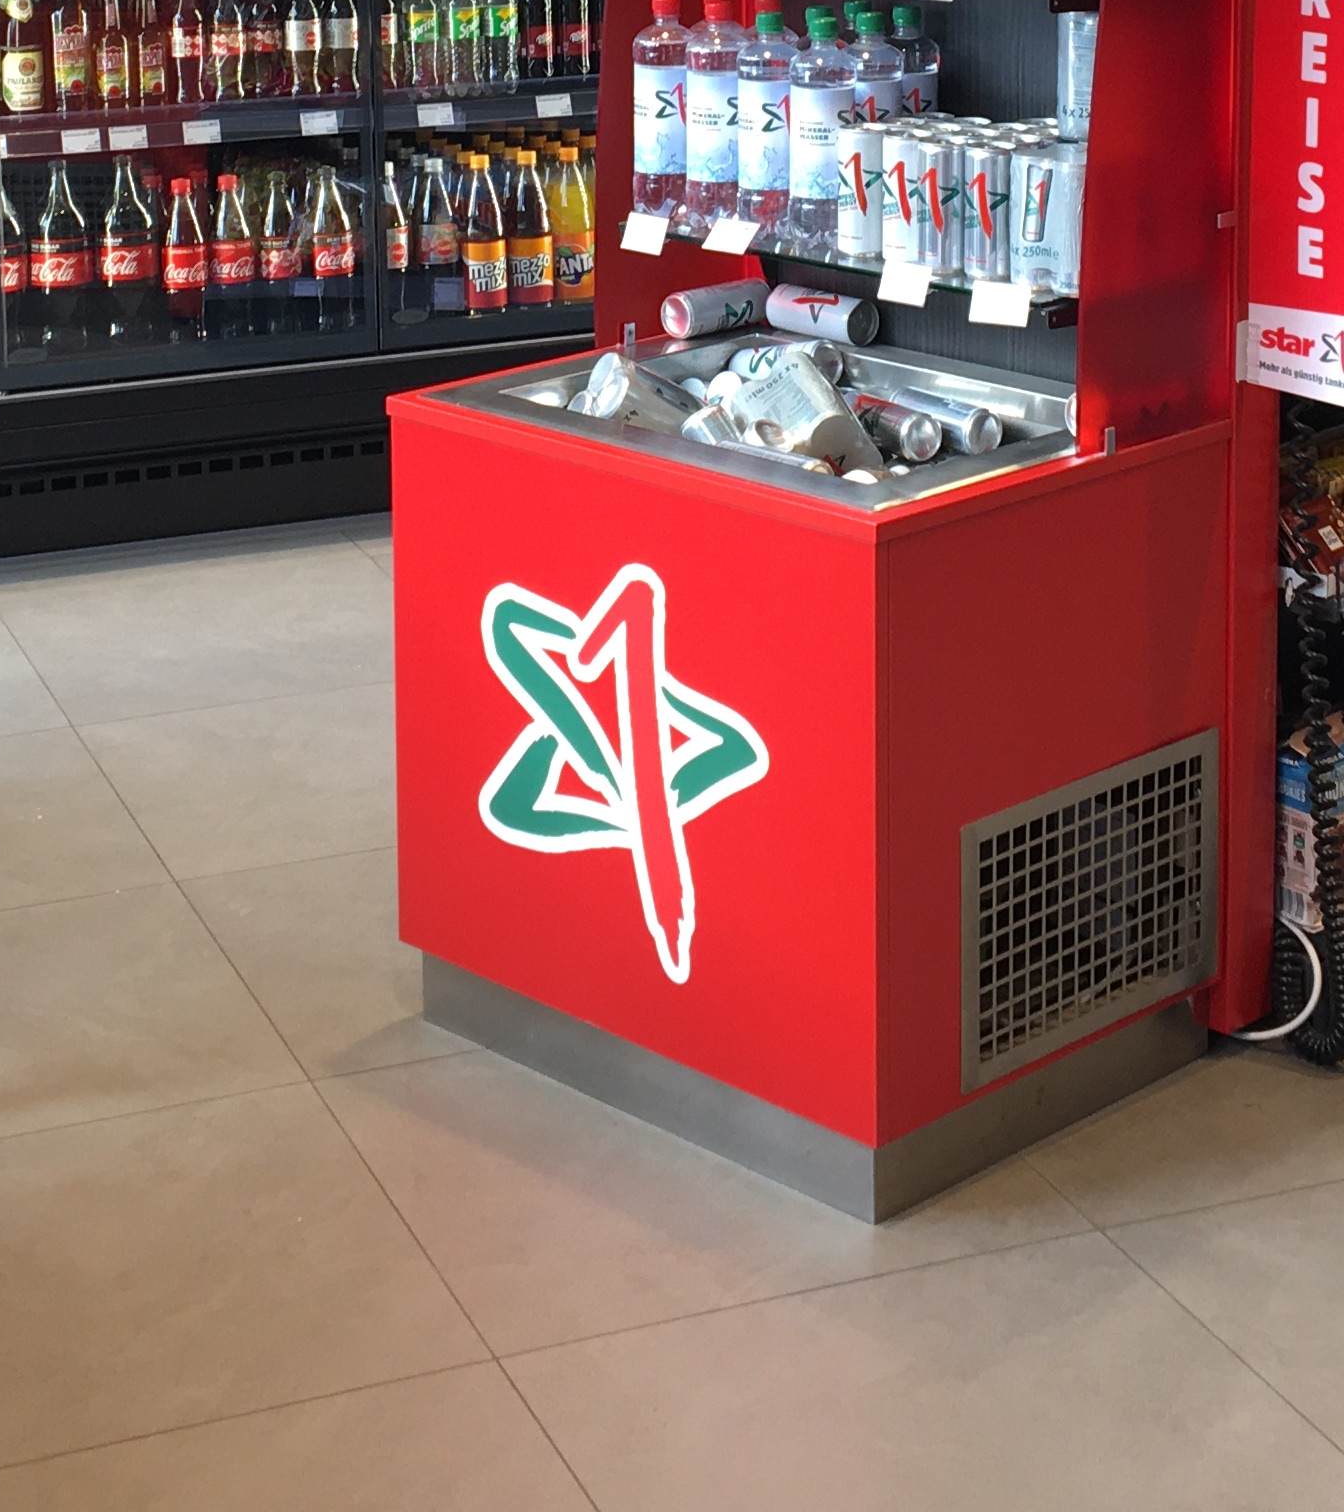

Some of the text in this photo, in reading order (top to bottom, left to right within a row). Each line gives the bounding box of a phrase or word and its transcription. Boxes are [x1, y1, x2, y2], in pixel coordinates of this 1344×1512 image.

[1259, 326, 1316, 358] star
[1258, 360, 1281, 373] Mehr
[1293, 369, 1323, 386] günstig
